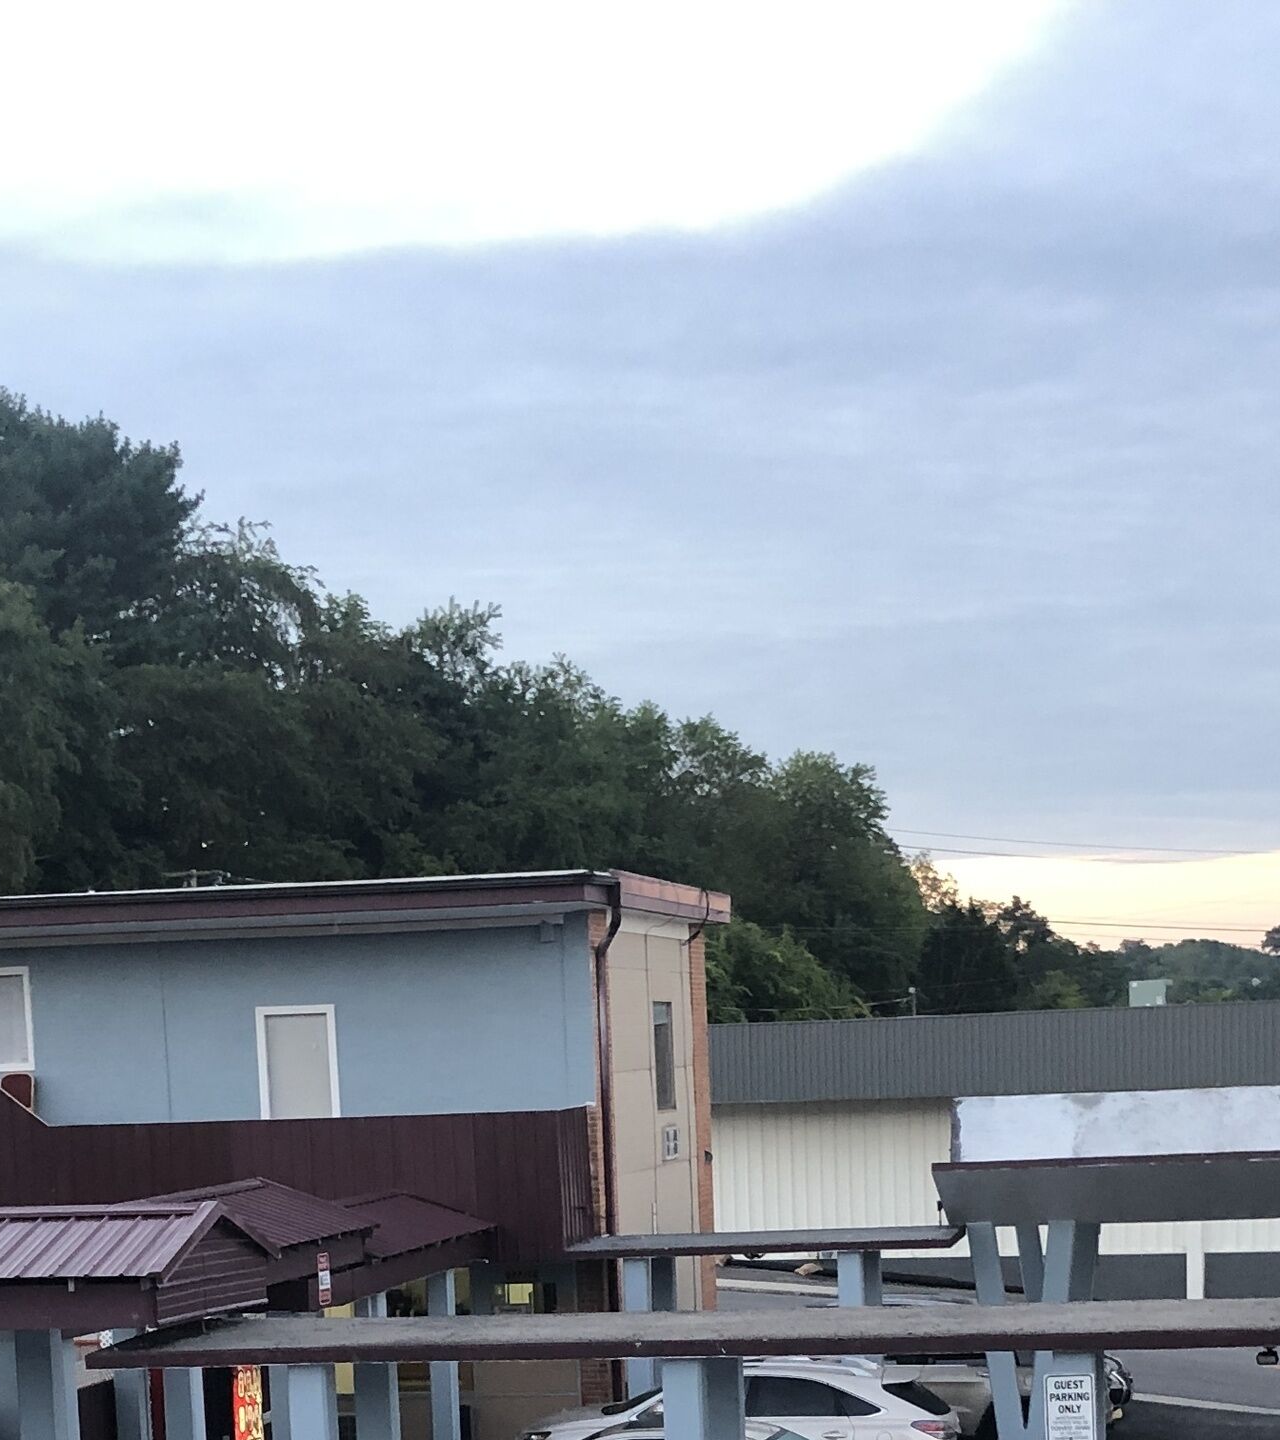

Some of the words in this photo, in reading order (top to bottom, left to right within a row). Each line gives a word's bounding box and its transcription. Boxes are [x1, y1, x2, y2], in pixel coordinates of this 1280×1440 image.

[1053, 1380, 1085, 1390] GUEST
[1049, 1392, 1090, 1402] PARKING
[1057, 1404, 1082, 1414] ONLY
